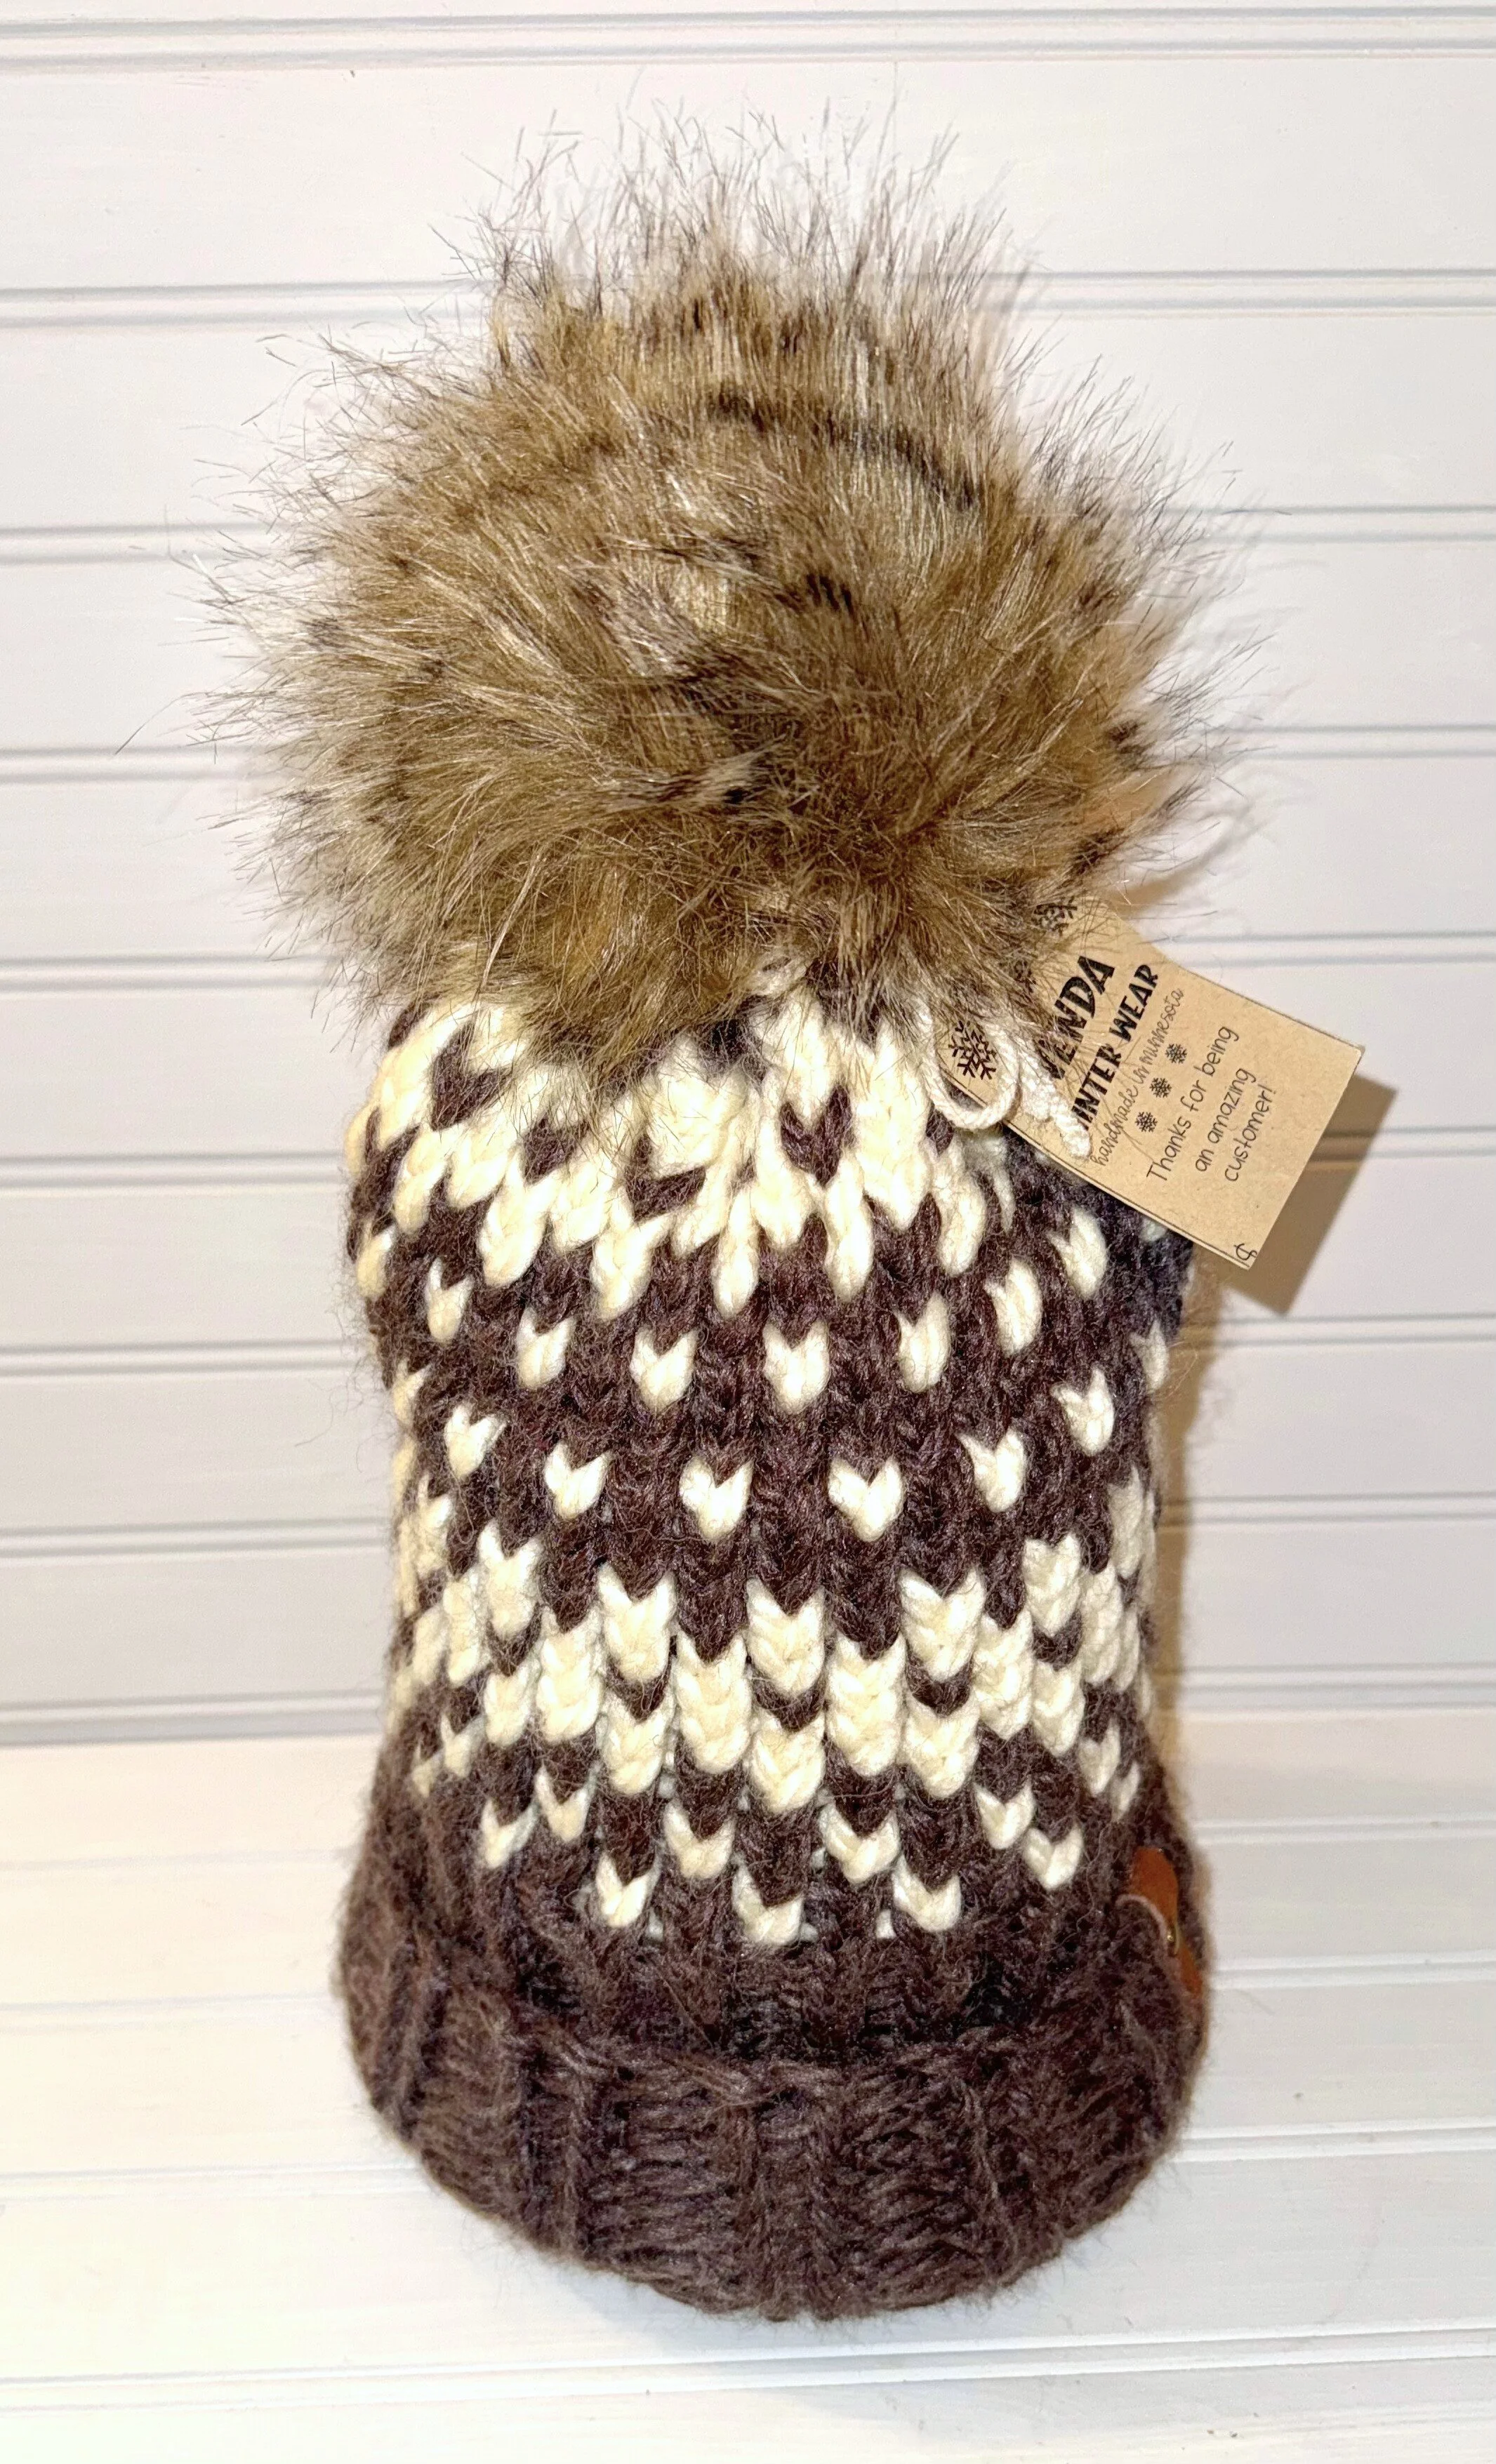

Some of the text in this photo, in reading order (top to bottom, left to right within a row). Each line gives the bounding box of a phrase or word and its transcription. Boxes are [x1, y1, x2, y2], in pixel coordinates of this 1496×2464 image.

[1070, 964, 1158, 1131] INTER WEAR
[1090, 1084, 1138, 1166] handmade
[1139, 988, 1184, 1065] minnesota
[1146, 1026, 1240, 1182] Thanks for being
[1195, 1067, 1257, 1172] an amazing
[1224, 1083, 1276, 1182] customer!
